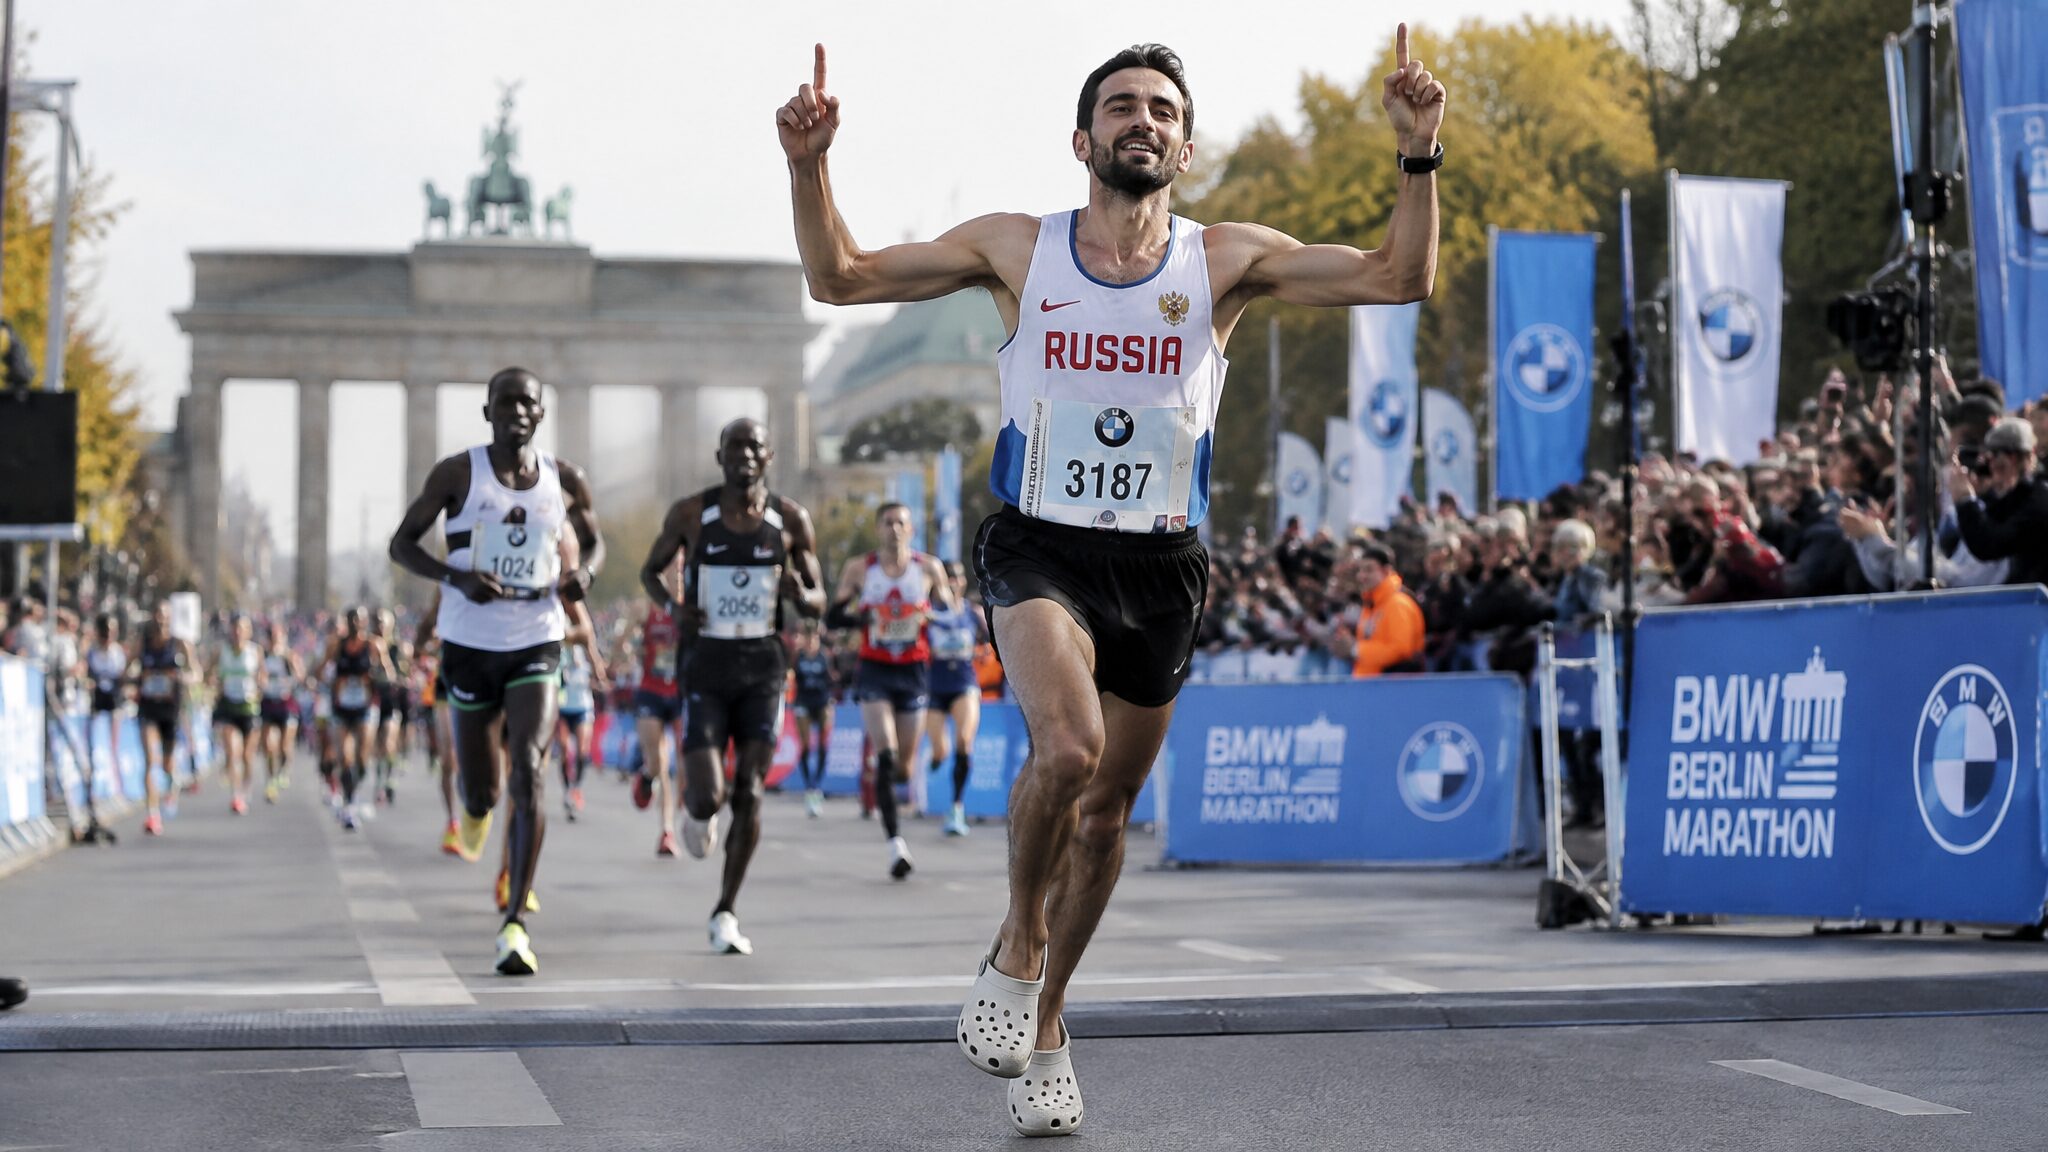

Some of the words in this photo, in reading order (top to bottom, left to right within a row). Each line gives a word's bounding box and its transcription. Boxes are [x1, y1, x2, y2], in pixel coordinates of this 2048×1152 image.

[1044, 330, 1183, 376] RUSSIA
[1064, 458, 1153, 501] 3187
[491, 555, 536, 579] 1024
[717, 595, 761, 618] 2056
[1671, 672, 1780, 743] BMW
[1205, 724, 1294, 766] BMW
[1202, 766, 1292, 796] BERLIN
[1666, 751, 1775, 800] BERLIN
[1200, 795, 1341, 825] MARATHON
[1662, 807, 1836, 859] MARATHON
